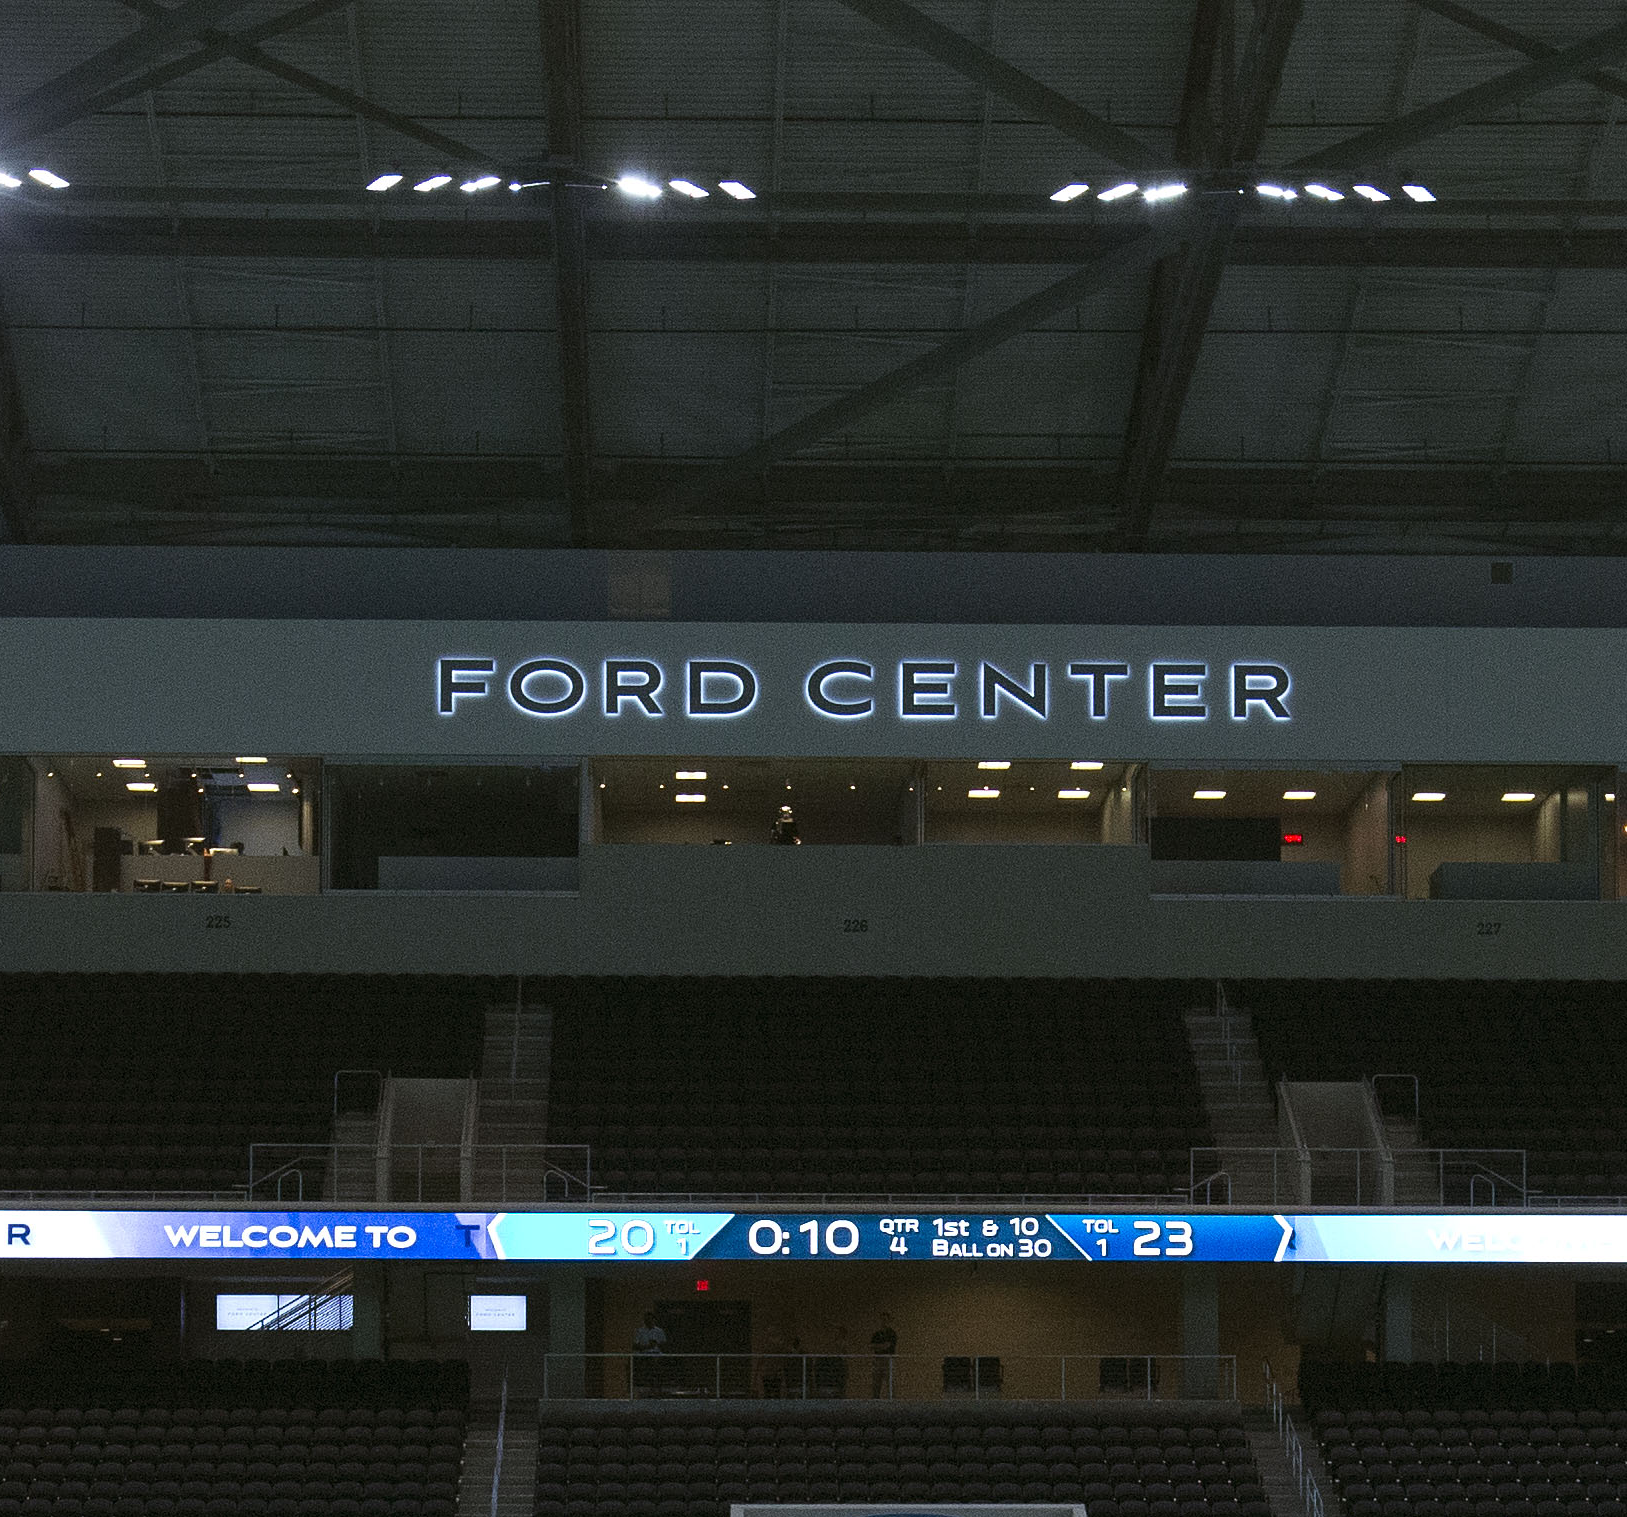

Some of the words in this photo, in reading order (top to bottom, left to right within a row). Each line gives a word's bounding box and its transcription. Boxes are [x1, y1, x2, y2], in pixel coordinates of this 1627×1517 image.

[435, 656, 759, 719] FORD
[806, 660, 1293, 721] CENTER
[206, 915, 231, 928] 225
[843, 919, 868, 932] 226
[1477, 922, 1502, 935] 227
[665, 1220, 700, 1234] TOL
[879, 1218, 920, 1233] QTR
[933, 1217, 969, 1237] 1st
[982, 1218, 999, 1237] &
[1010, 1217, 1039, 1236] 10
[1083, 1219, 1119, 1233] TOL
[164, 1225, 357, 1248] WELCOME
[365, 1225, 417, 1248] TO
[588, 1219, 655, 1254] 20
[748, 1219, 860, 1255] 0:10
[1133, 1221, 1194, 1256] 23
[890, 1237, 908, 1255] 4
[1018, 1239, 1052, 1257] 30
[1096, 1239, 1107, 1256] 1
